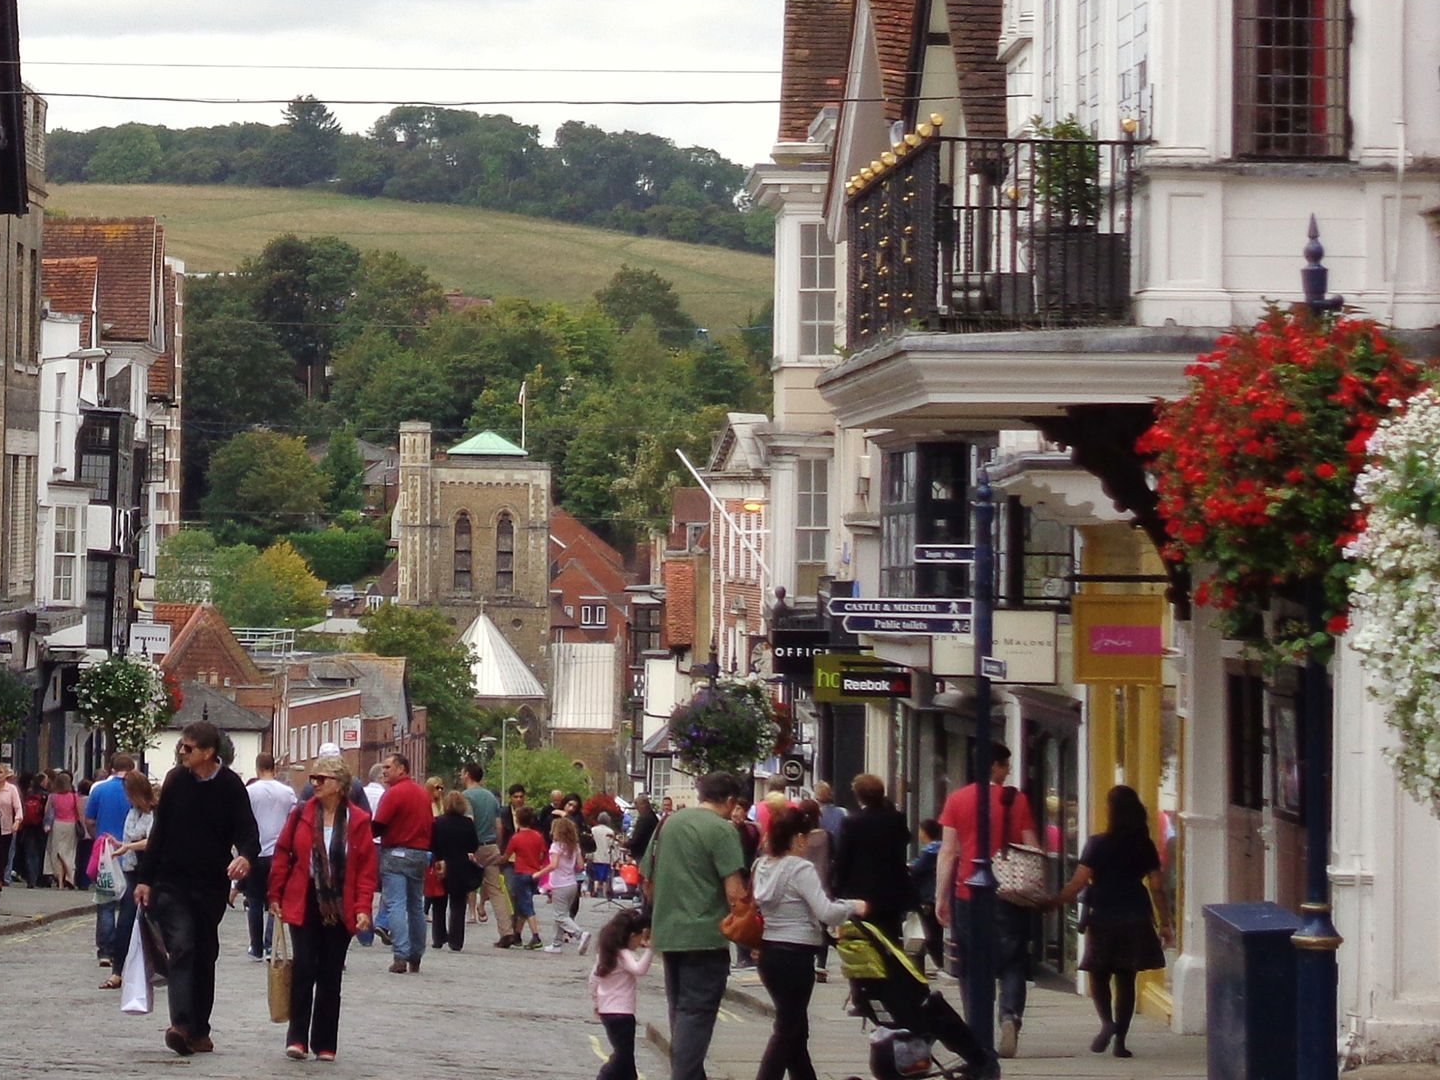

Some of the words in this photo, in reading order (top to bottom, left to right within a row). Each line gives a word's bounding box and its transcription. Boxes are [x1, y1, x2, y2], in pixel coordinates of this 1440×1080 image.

[844, 603, 881, 612] CASTLE
[882, 603, 891, 612] &
[893, 603, 937, 613] MUSEUM
[874, 619, 901, 630] Public
[902, 620, 928, 630] toilets
[774, 647, 831, 657] OFFICE
[843, 678, 890, 691] Reebok
